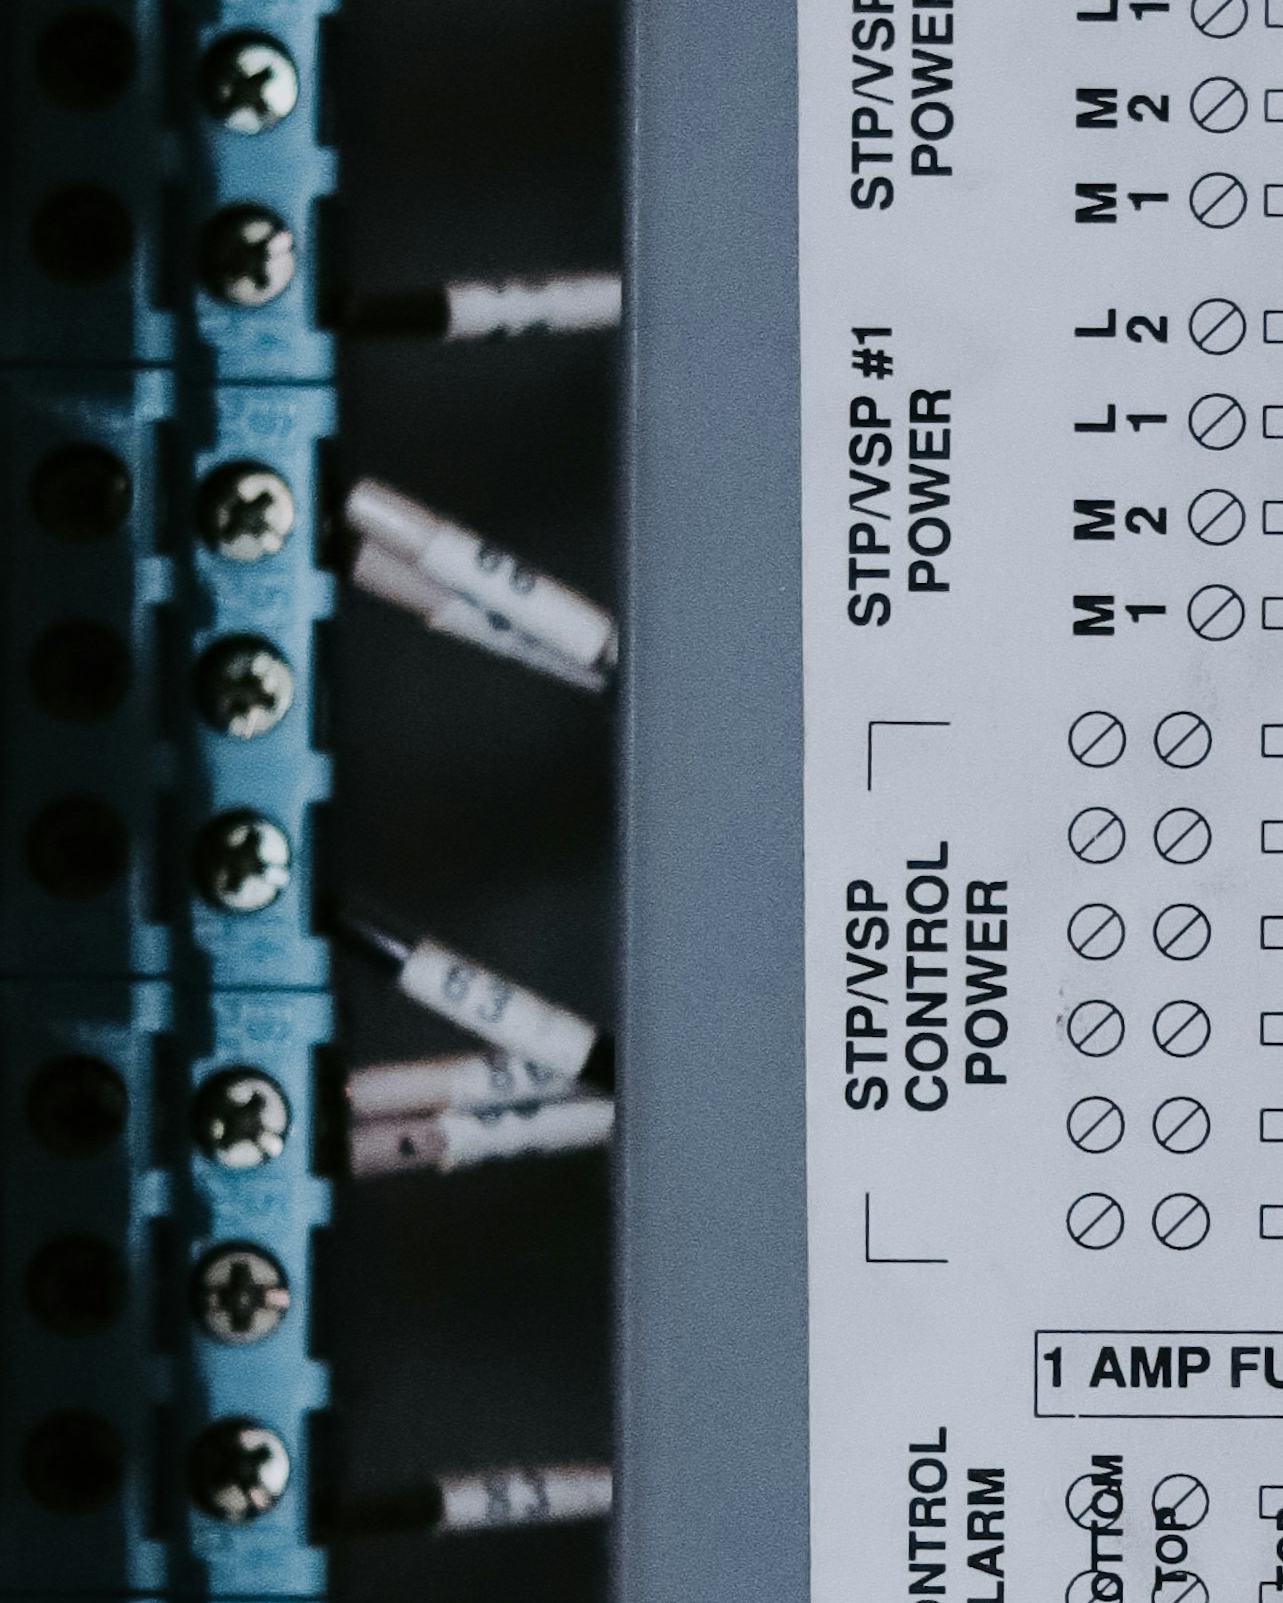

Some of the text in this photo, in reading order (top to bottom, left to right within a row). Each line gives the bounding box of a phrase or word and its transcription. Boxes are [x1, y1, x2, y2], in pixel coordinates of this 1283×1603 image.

[1129, 3, 1169, 20] 1
[1076, 88, 1117, 128] M
[1127, 95, 1169, 122] 2
[1075, 183, 1117, 223] M
[1128, 193, 1168, 210] 1
[1075, 309, 1116, 337] L
[1126, 316, 1168, 343] 2
[1074, 404, 1116, 432] L
[1126, 414, 1167, 432] 1
[848, 328, 893, 626] STP/VSP #1
[908, 389, 951, 592] POWER
[1074, 499, 1115, 540] M
[1125, 507, 1167, 534] 2
[1073, 595, 1114, 636] M
[1125, 605, 1166, 622] 1
[845, 880, 889, 1110] STP/VSP
[905, 841, 949, 1111] CONTROL
[965, 881, 1008, 1084] POWER
[1042, 1346, 1064, 1390] 1
[1090, 1346, 1210, 1388] AMP
[1155, 1506, 1188, 1590] TOP
